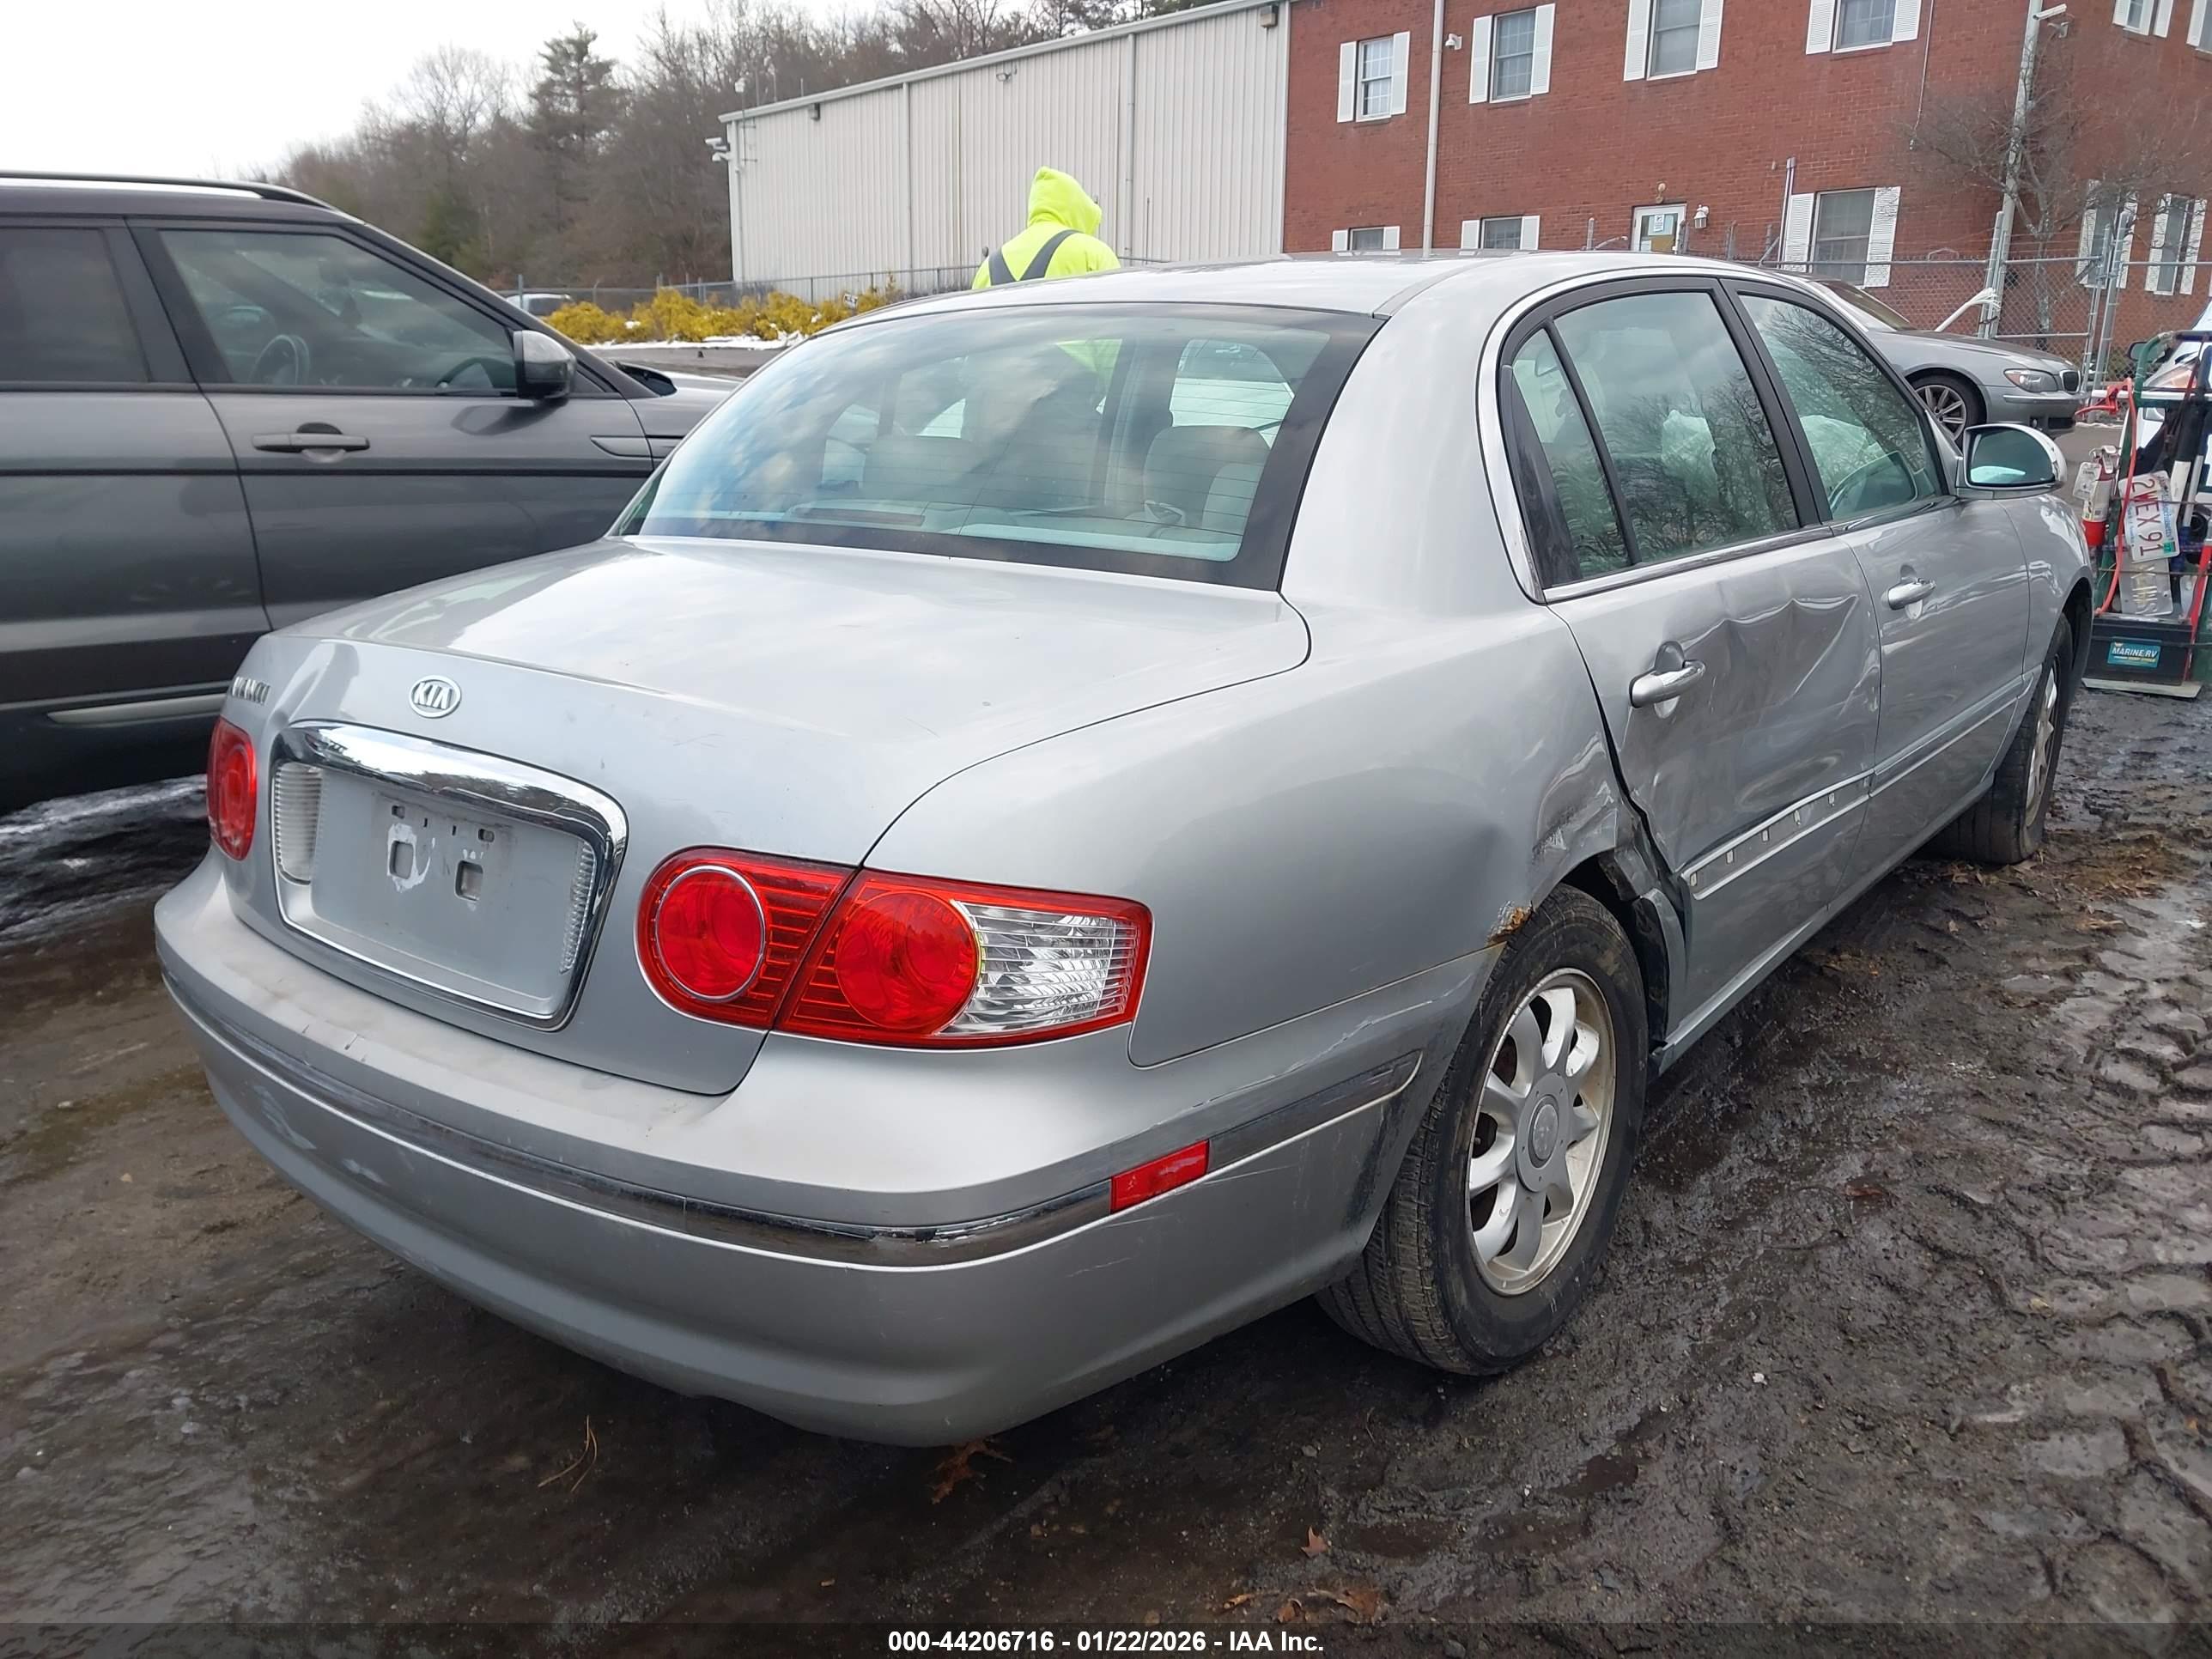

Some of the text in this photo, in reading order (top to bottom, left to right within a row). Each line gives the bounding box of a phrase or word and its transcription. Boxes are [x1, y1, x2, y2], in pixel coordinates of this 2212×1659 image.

[2131, 478, 2163, 556] 2WEX 91
[2112, 647, 2145, 658] MARINE
[414, 682, 453, 709] KIA
